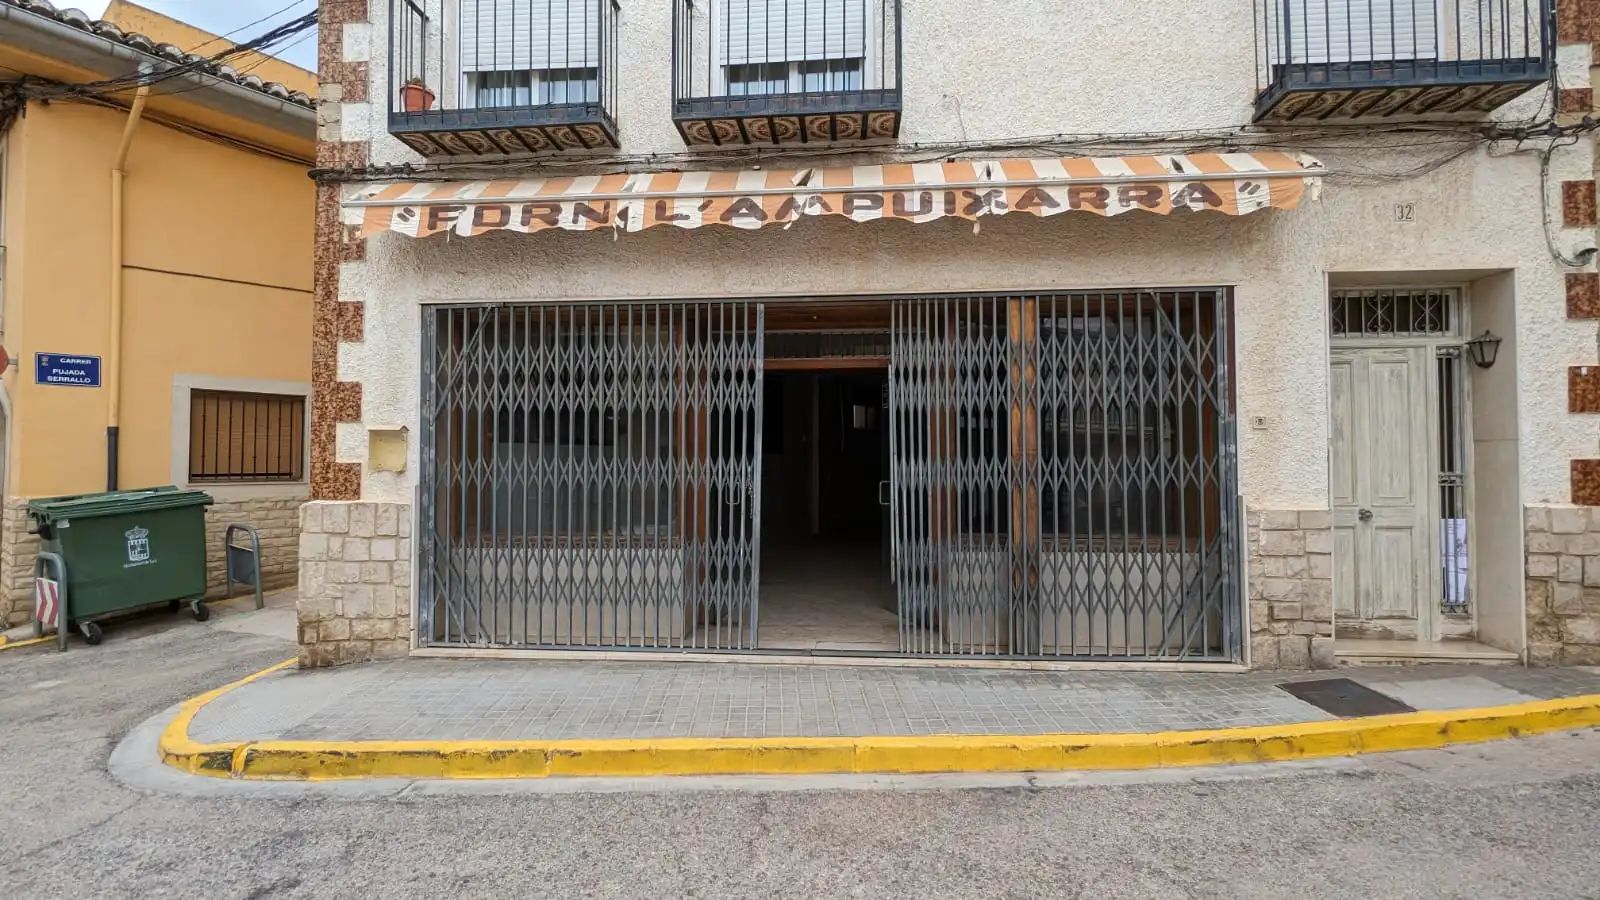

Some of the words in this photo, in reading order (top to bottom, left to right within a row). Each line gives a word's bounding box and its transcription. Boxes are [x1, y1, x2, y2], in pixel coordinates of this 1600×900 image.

[1396, 202, 1412, 220] 32
[52, 368, 86, 376] PUJADA
[47, 375, 91, 384] SERRALLO
